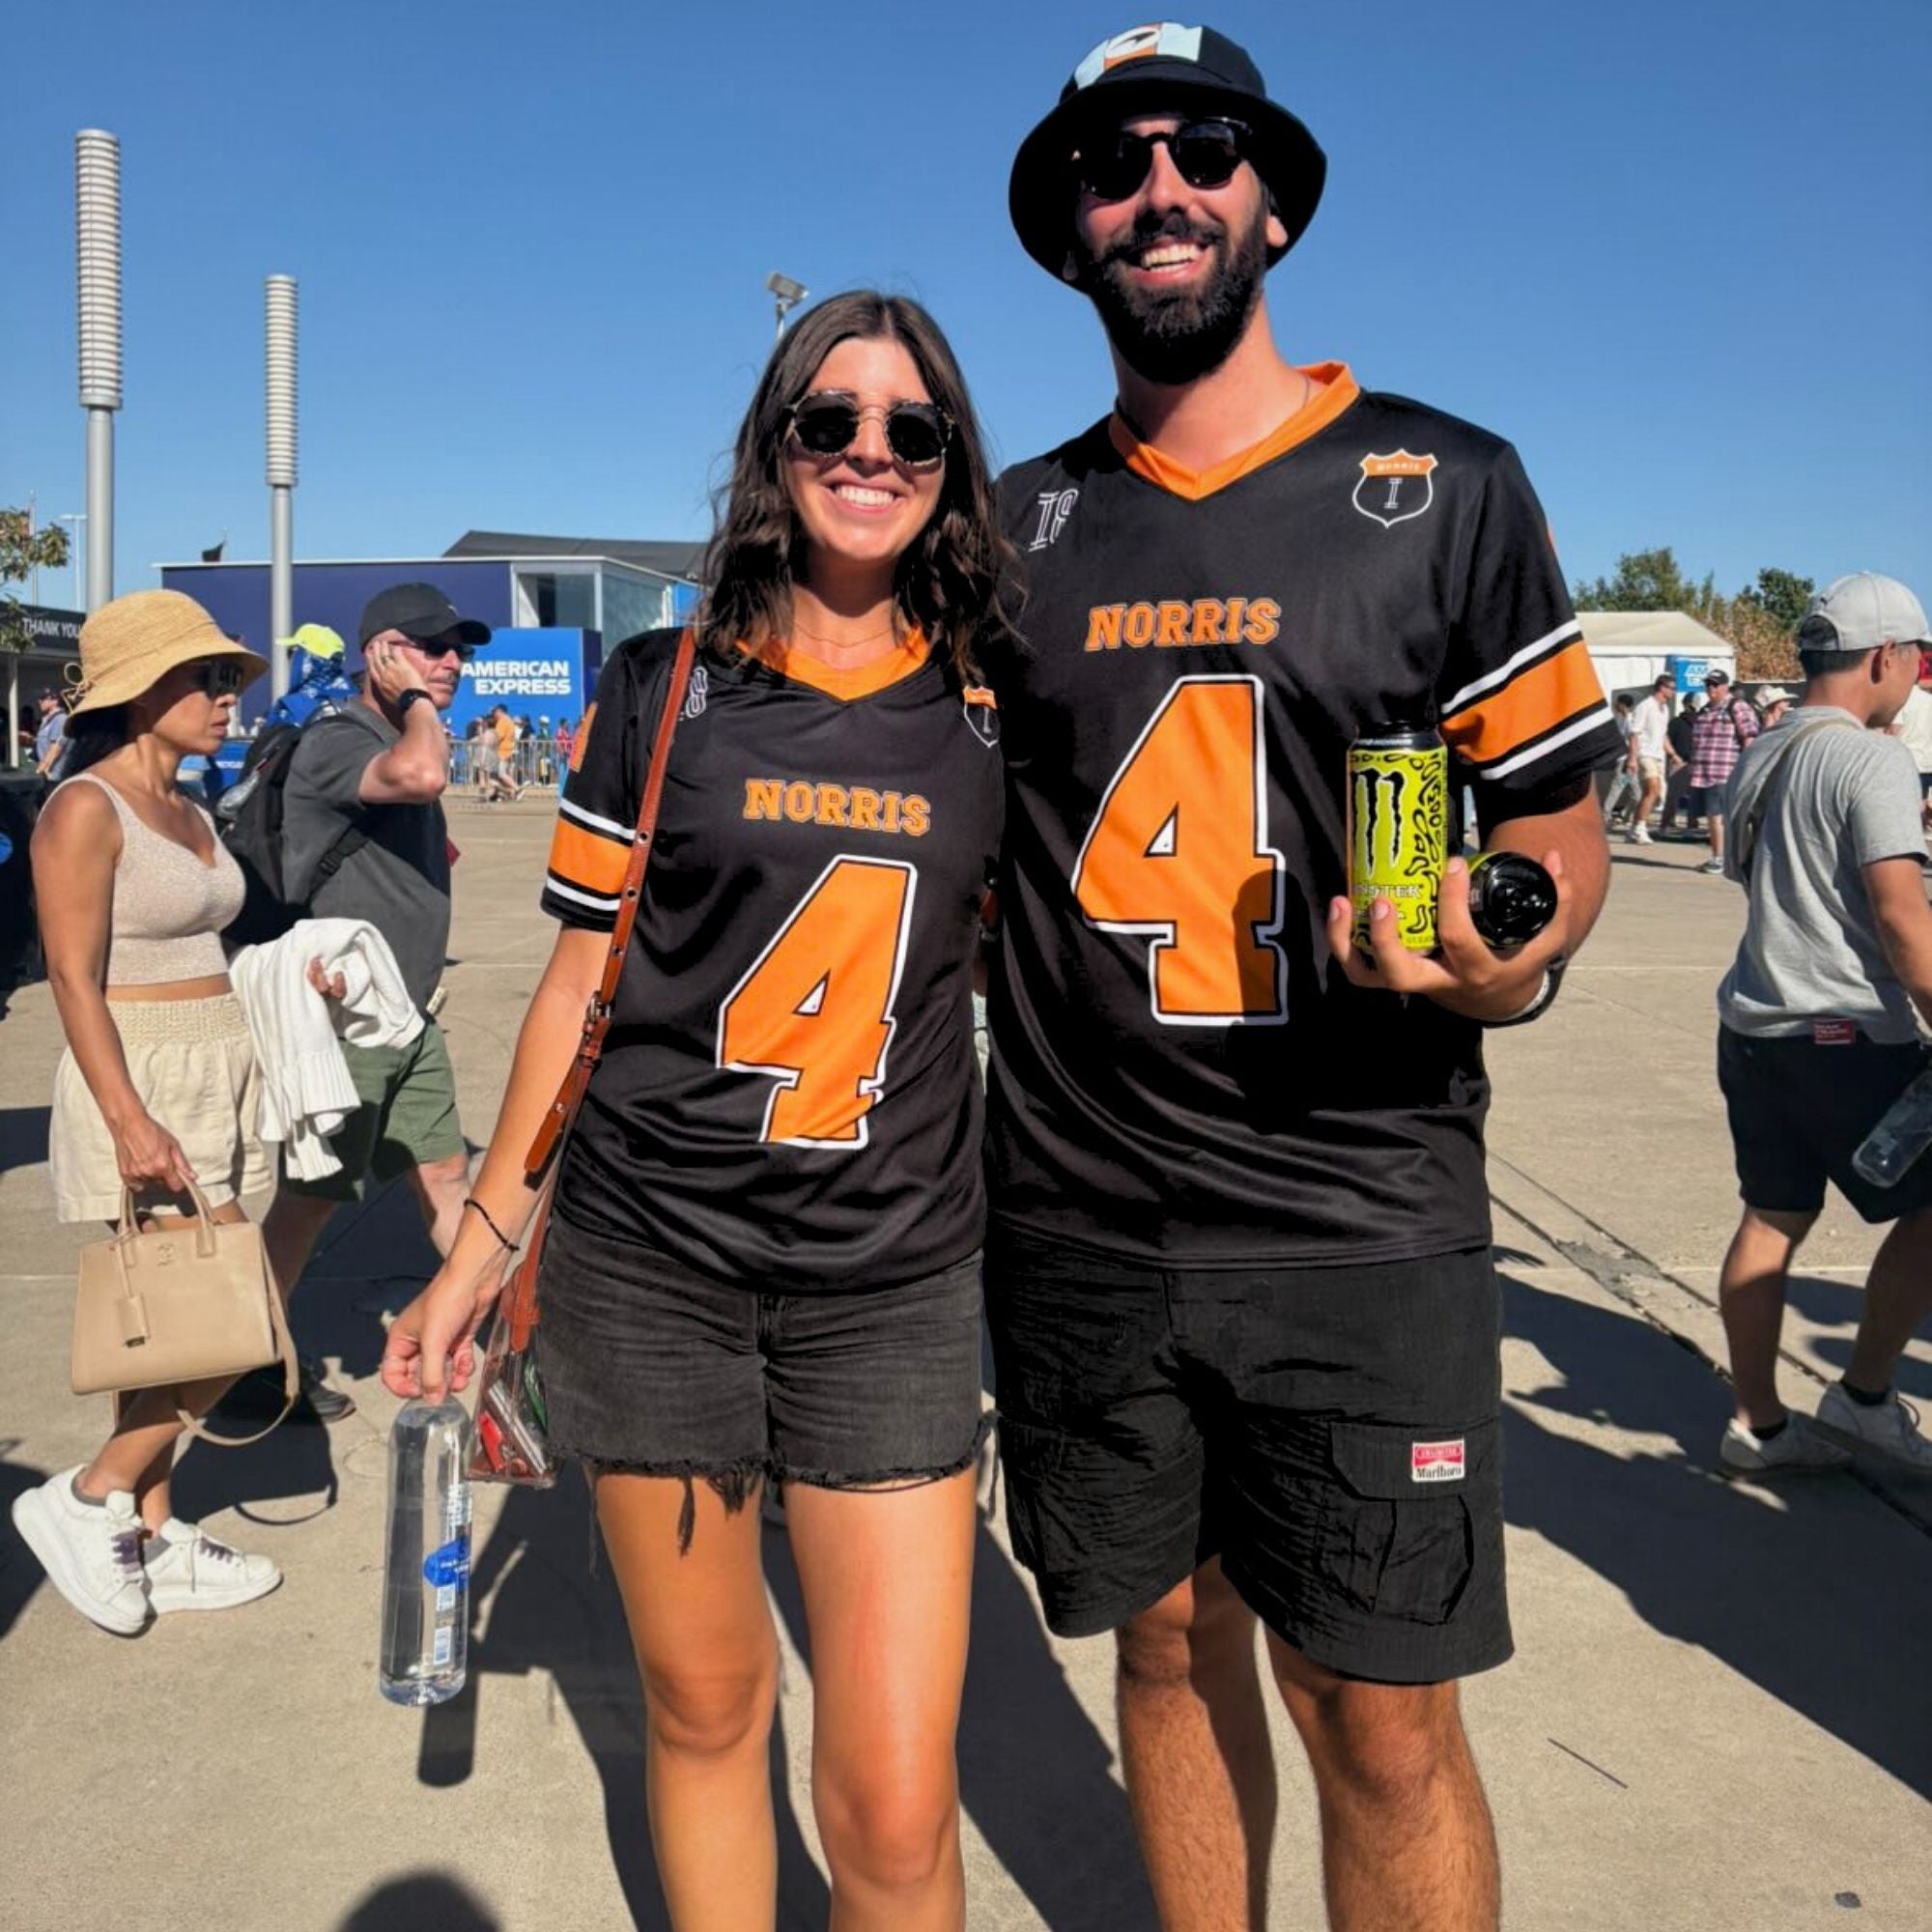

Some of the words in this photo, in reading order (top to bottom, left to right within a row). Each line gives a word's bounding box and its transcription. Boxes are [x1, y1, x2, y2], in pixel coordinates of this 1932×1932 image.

[21, 616, 59, 637] THANK
[1084, 597, 1282, 653] NORRIS
[461, 660, 570, 677] AMERICAN
[474, 678, 572, 695] EXPRESS
[743, 779, 930, 837] NORRIS
[1070, 674, 1289, 1026] 4
[716, 853, 918, 1149] 4
